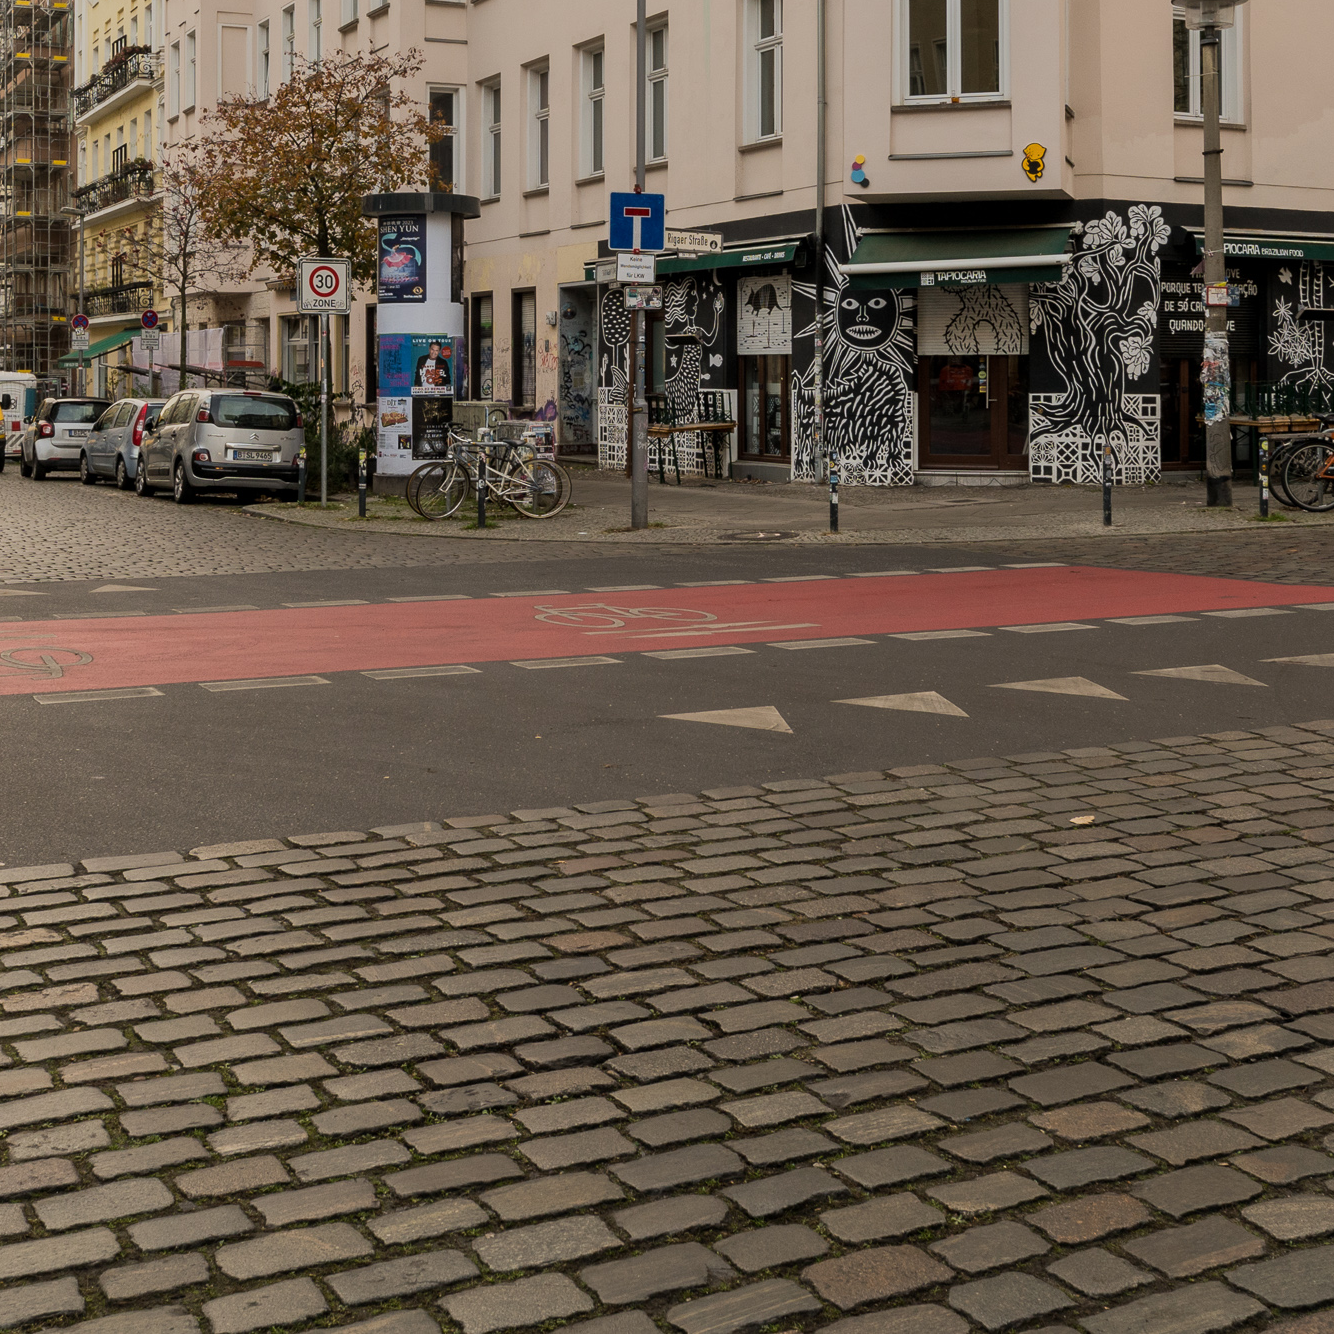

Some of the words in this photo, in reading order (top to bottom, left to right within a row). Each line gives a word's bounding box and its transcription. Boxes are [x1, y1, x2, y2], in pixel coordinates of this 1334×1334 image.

[380, 225, 397, 233] SHEN
[399, 225, 419, 233] YUN
[667, 232, 688, 247] Rigaer
[688, 234, 708, 247] Straße
[1261, 247, 1288, 257] BRAZILIAN
[1288, 249, 1304, 257] FOOD
[315, 274, 333, 289] 30
[935, 270, 987, 281] TAPIOCARIA
[1161, 282, 1191, 297] PORQUE
[313, 299, 336, 307] ZONE
[1164, 301, 1175, 312] DE
[1178, 297, 1189, 312] SÓ
[1169, 319, 1204, 335] QUANDO
